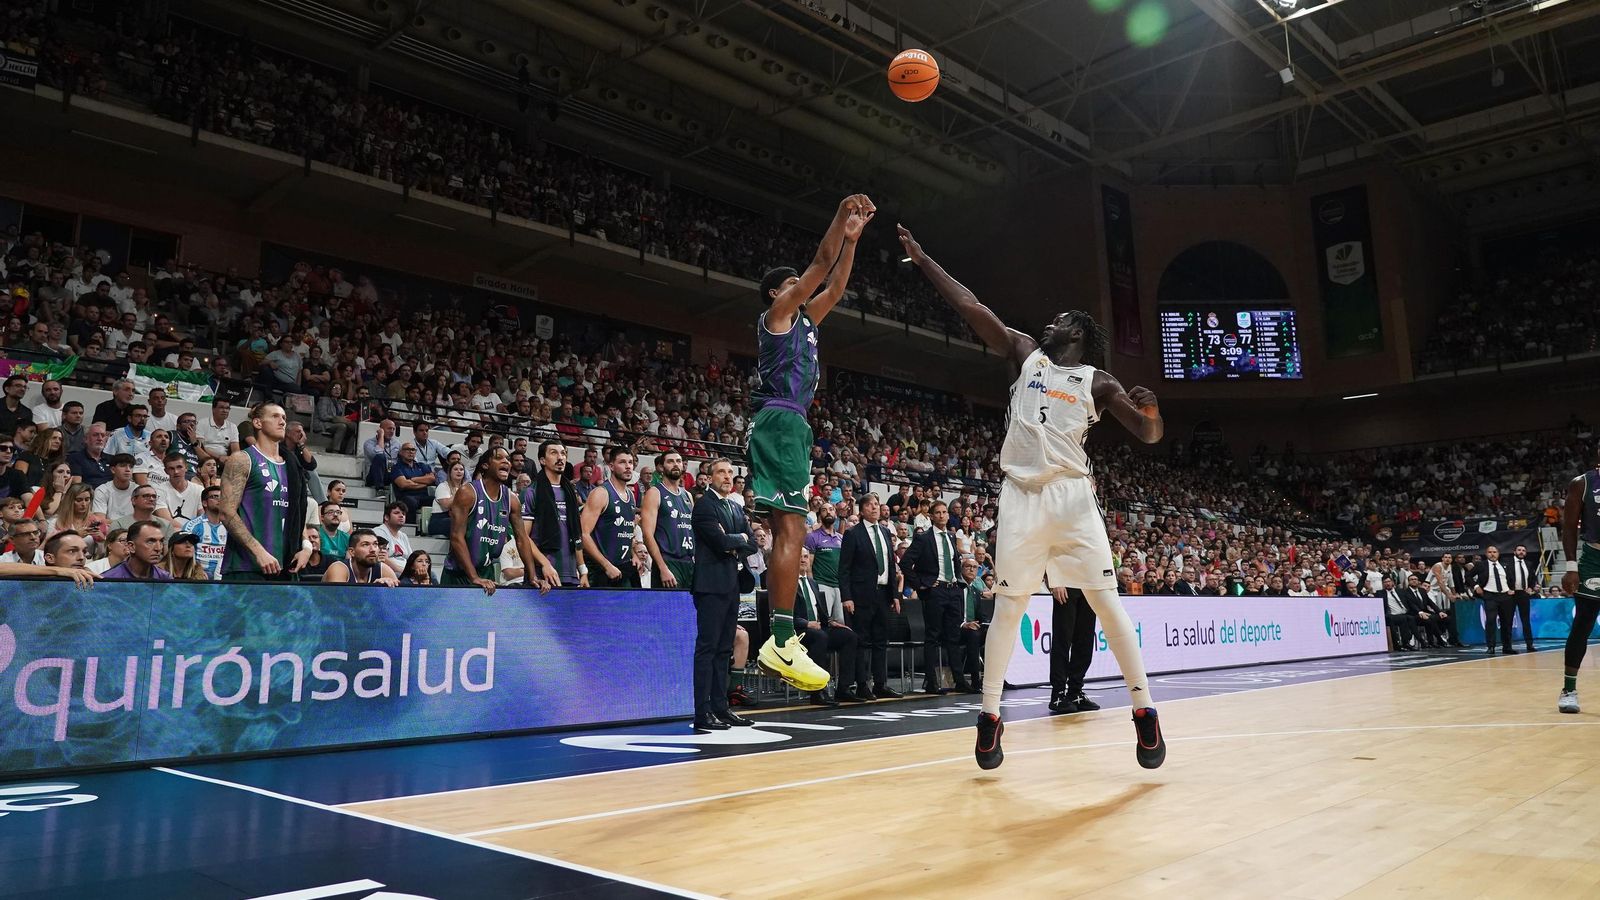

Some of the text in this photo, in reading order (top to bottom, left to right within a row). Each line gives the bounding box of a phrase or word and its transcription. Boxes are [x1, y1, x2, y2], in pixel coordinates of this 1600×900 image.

[1208, 334, 1221, 345] 73
[1240, 334, 1252, 345] 77
[1220, 347, 1242, 355] 3:09
[682, 536, 694, 550] 45
[621, 545, 629, 559] 7
[1165, 622, 1180, 647] La
[1183, 620, 1215, 645] salud
[1220, 619, 1238, 643] del
[1240, 618, 1282, 647] deporte
[1333, 616, 1380, 643] quirónsalud
[14, 631, 497, 742] quirónsalud
